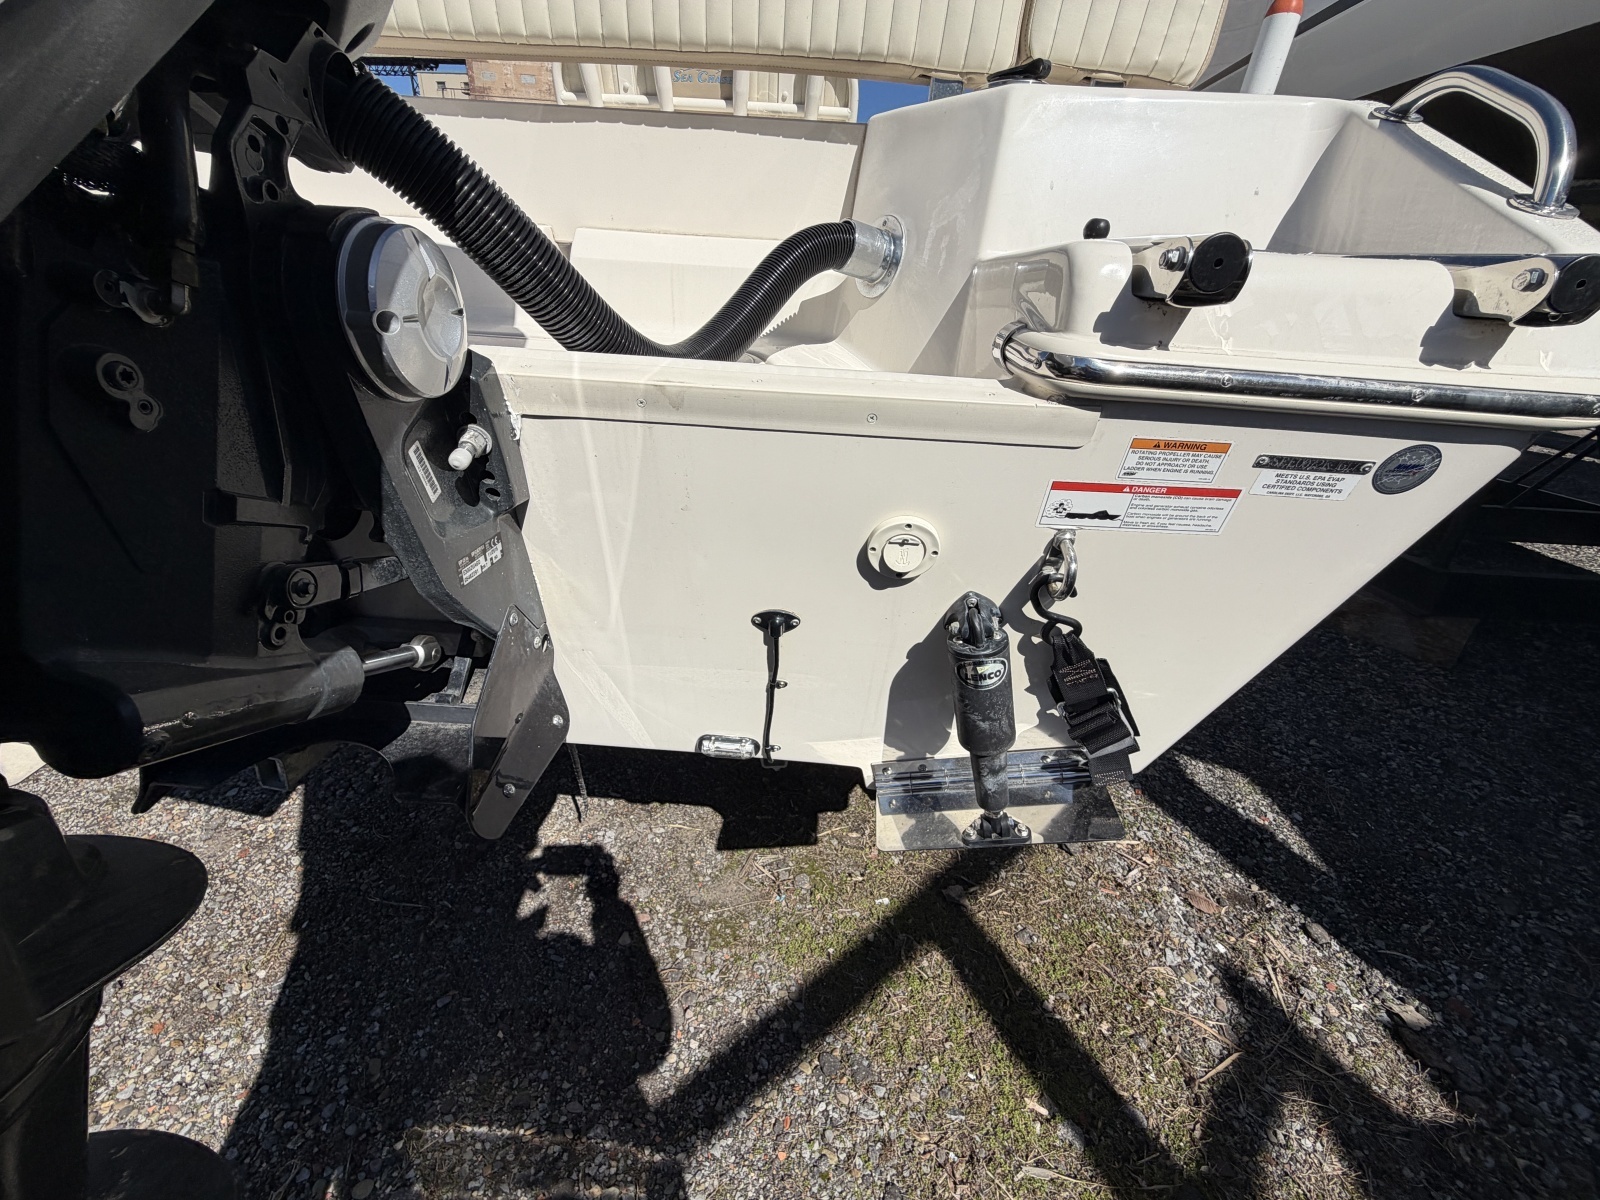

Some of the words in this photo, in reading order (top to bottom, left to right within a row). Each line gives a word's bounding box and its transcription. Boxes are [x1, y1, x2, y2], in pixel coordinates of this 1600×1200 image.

[1164, 441, 1207, 450] WARNING
[1262, 483, 1297, 491] CERTIFIED
[1297, 486, 1343, 494] COMPONENTS
[965, 669, 1002, 682] LENCO
